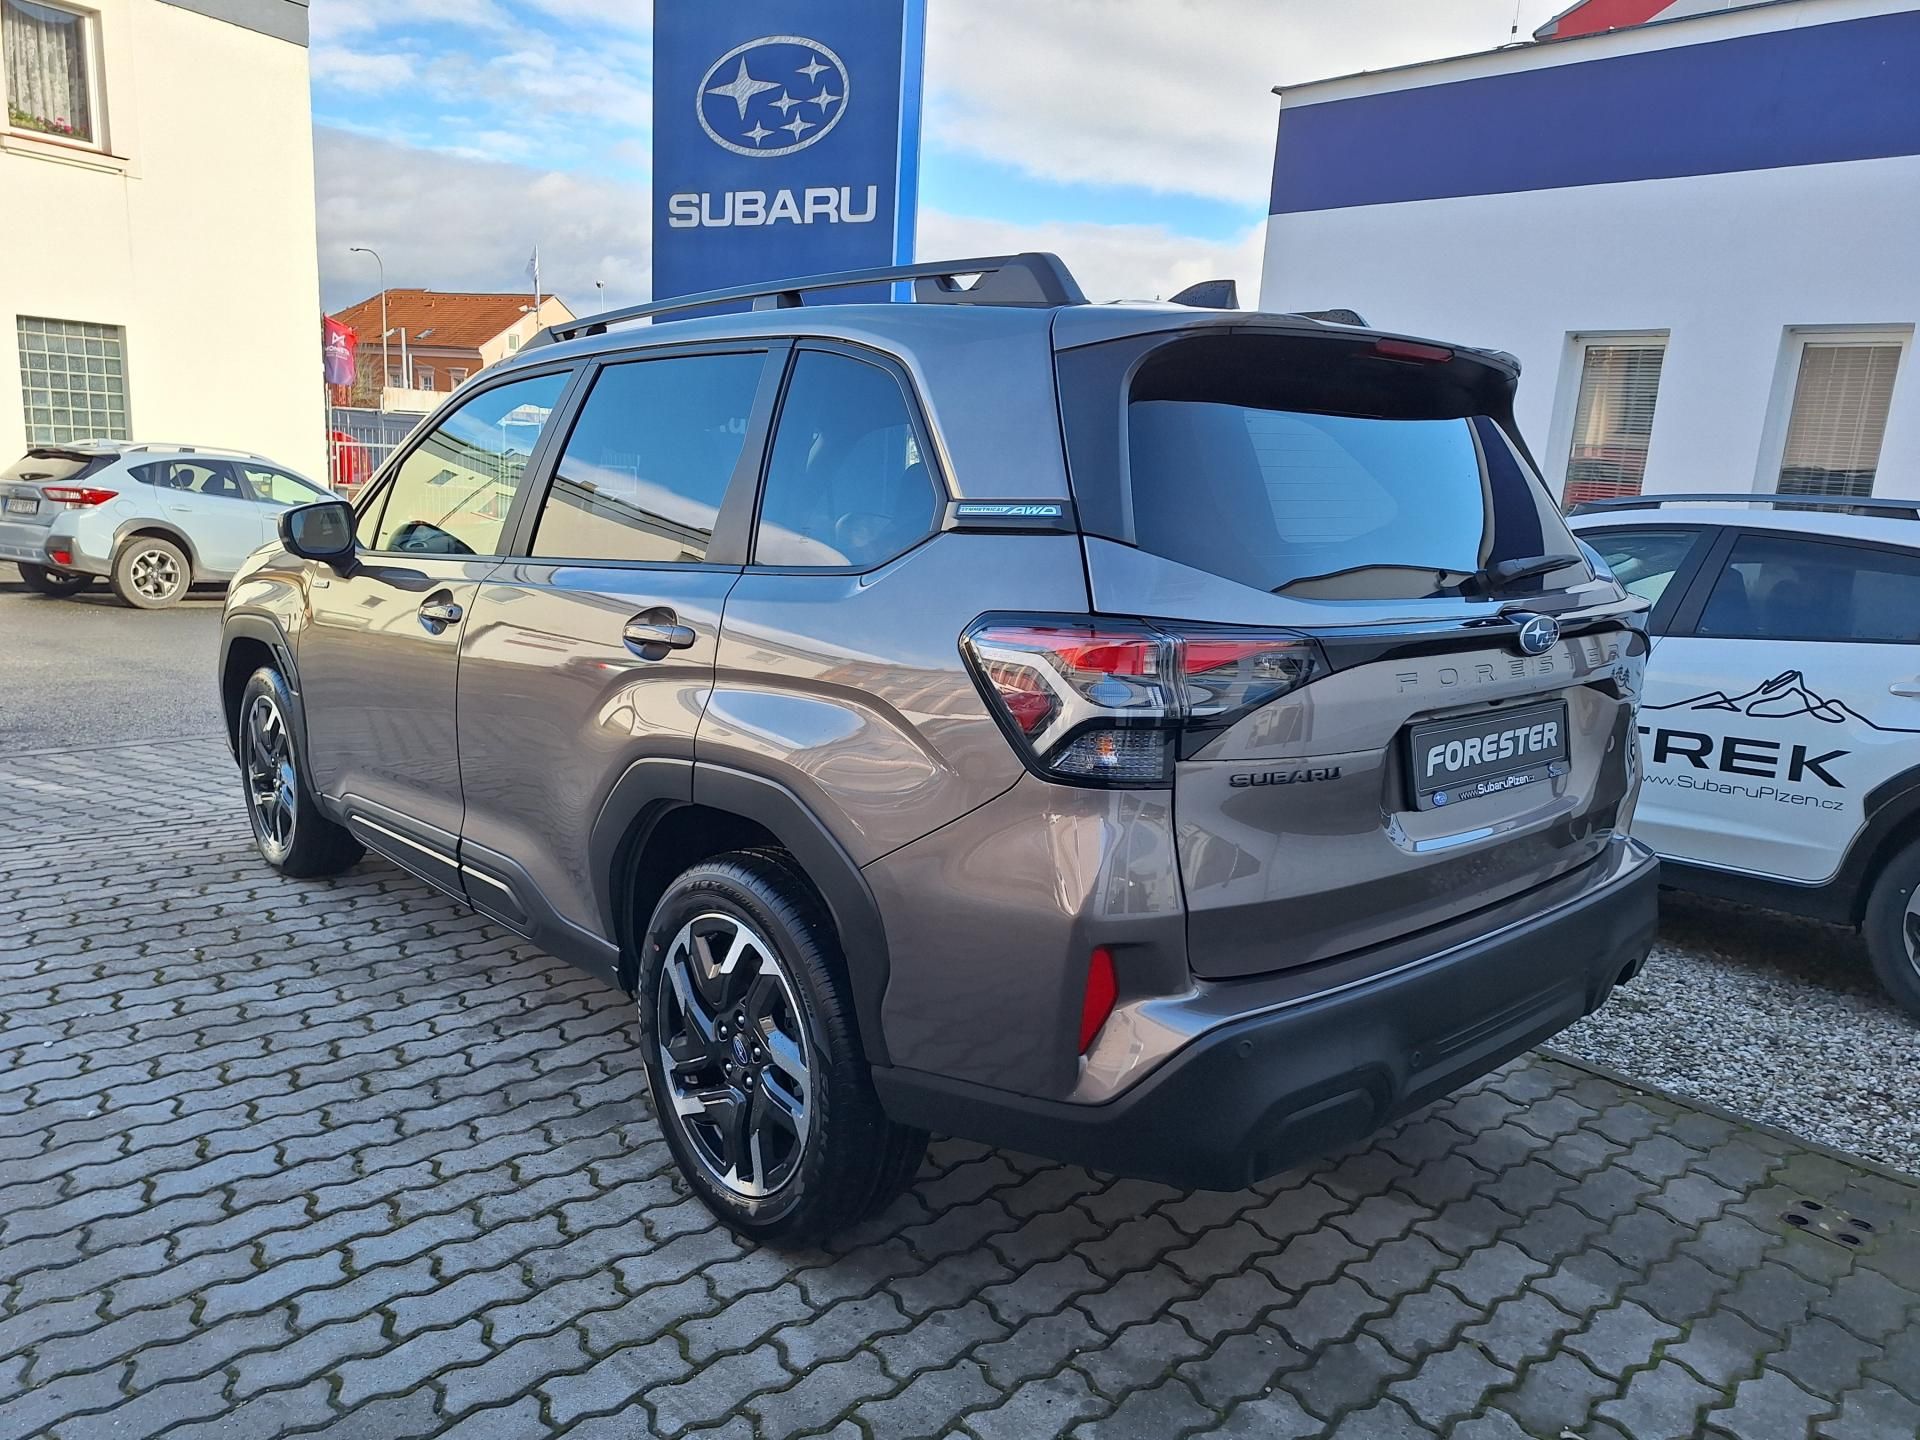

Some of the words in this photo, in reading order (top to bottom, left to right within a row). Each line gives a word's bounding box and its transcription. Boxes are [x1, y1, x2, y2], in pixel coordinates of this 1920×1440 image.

[668, 185, 877, 228] SUBARU
[1007, 505, 1057, 515] AWD
[1395, 643, 1620, 693] FORESTER
[1426, 721, 1558, 777] FORESTER
[1638, 726, 1851, 789] REK
[1229, 766, 1343, 787] SUBARU
[1459, 774, 1535, 800] www.SubaruPlzen.cz
